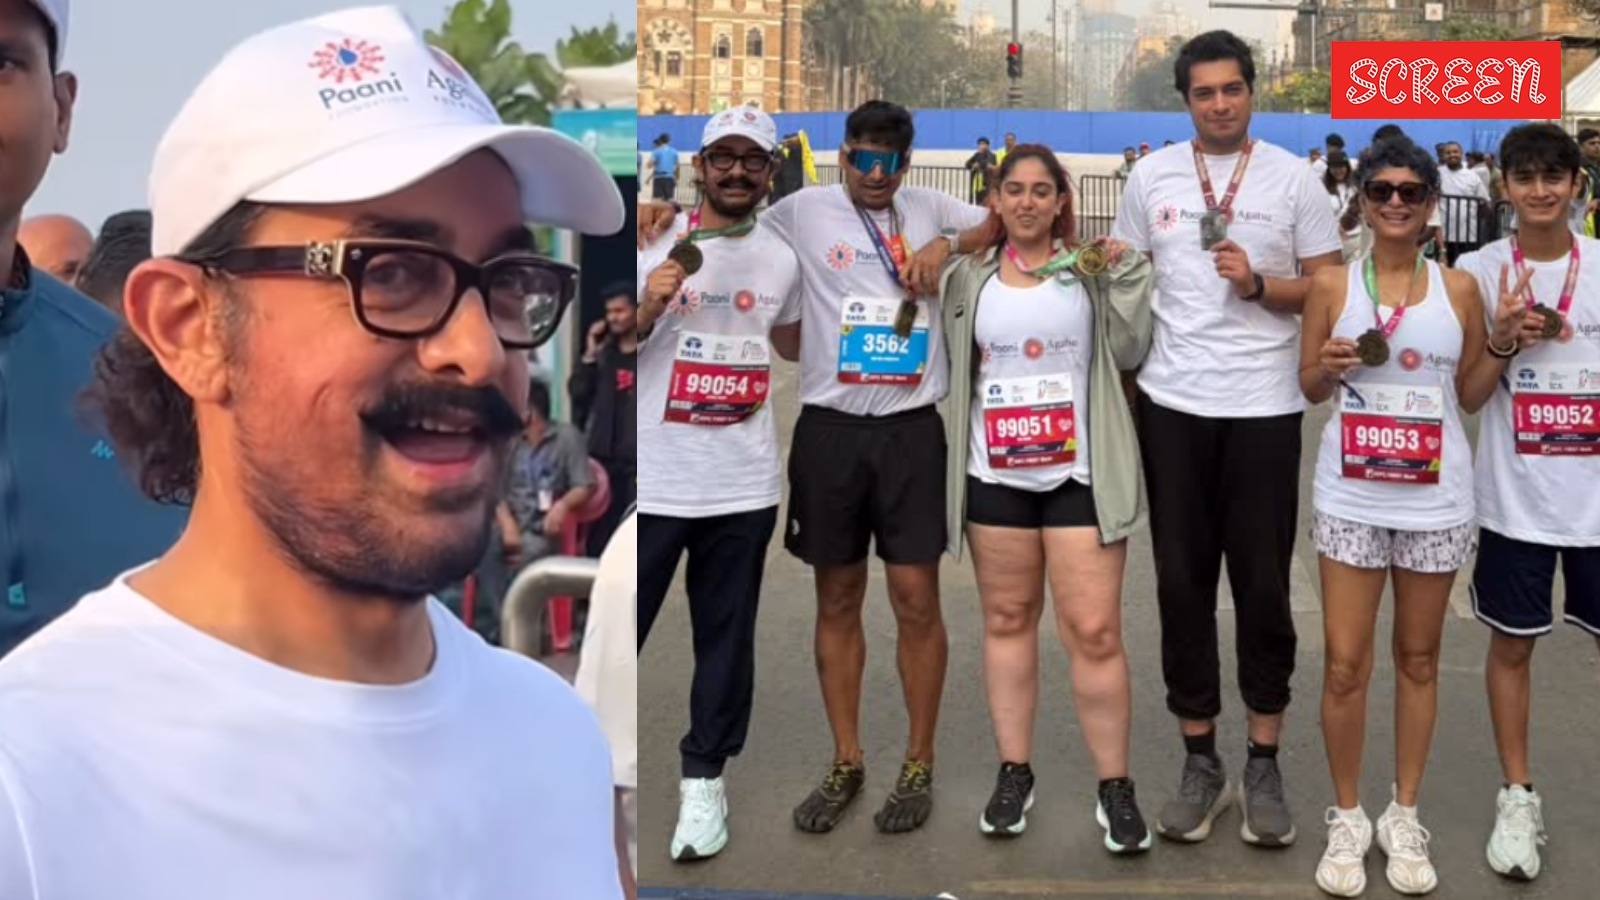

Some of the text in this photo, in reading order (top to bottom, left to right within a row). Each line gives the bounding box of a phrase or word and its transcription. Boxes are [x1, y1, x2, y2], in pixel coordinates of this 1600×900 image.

[318, 72, 403, 109] Paani
[700, 291, 730, 304] Paani
[680, 349, 704, 359] TATA
[862, 332, 909, 354] 3562
[686, 372, 749, 397] 99054
[1515, 381, 1540, 390] TATA
[1529, 403, 1594, 425] 99052
[996, 414, 1052, 439] 99051
[1355, 425, 1419, 450] 99053
